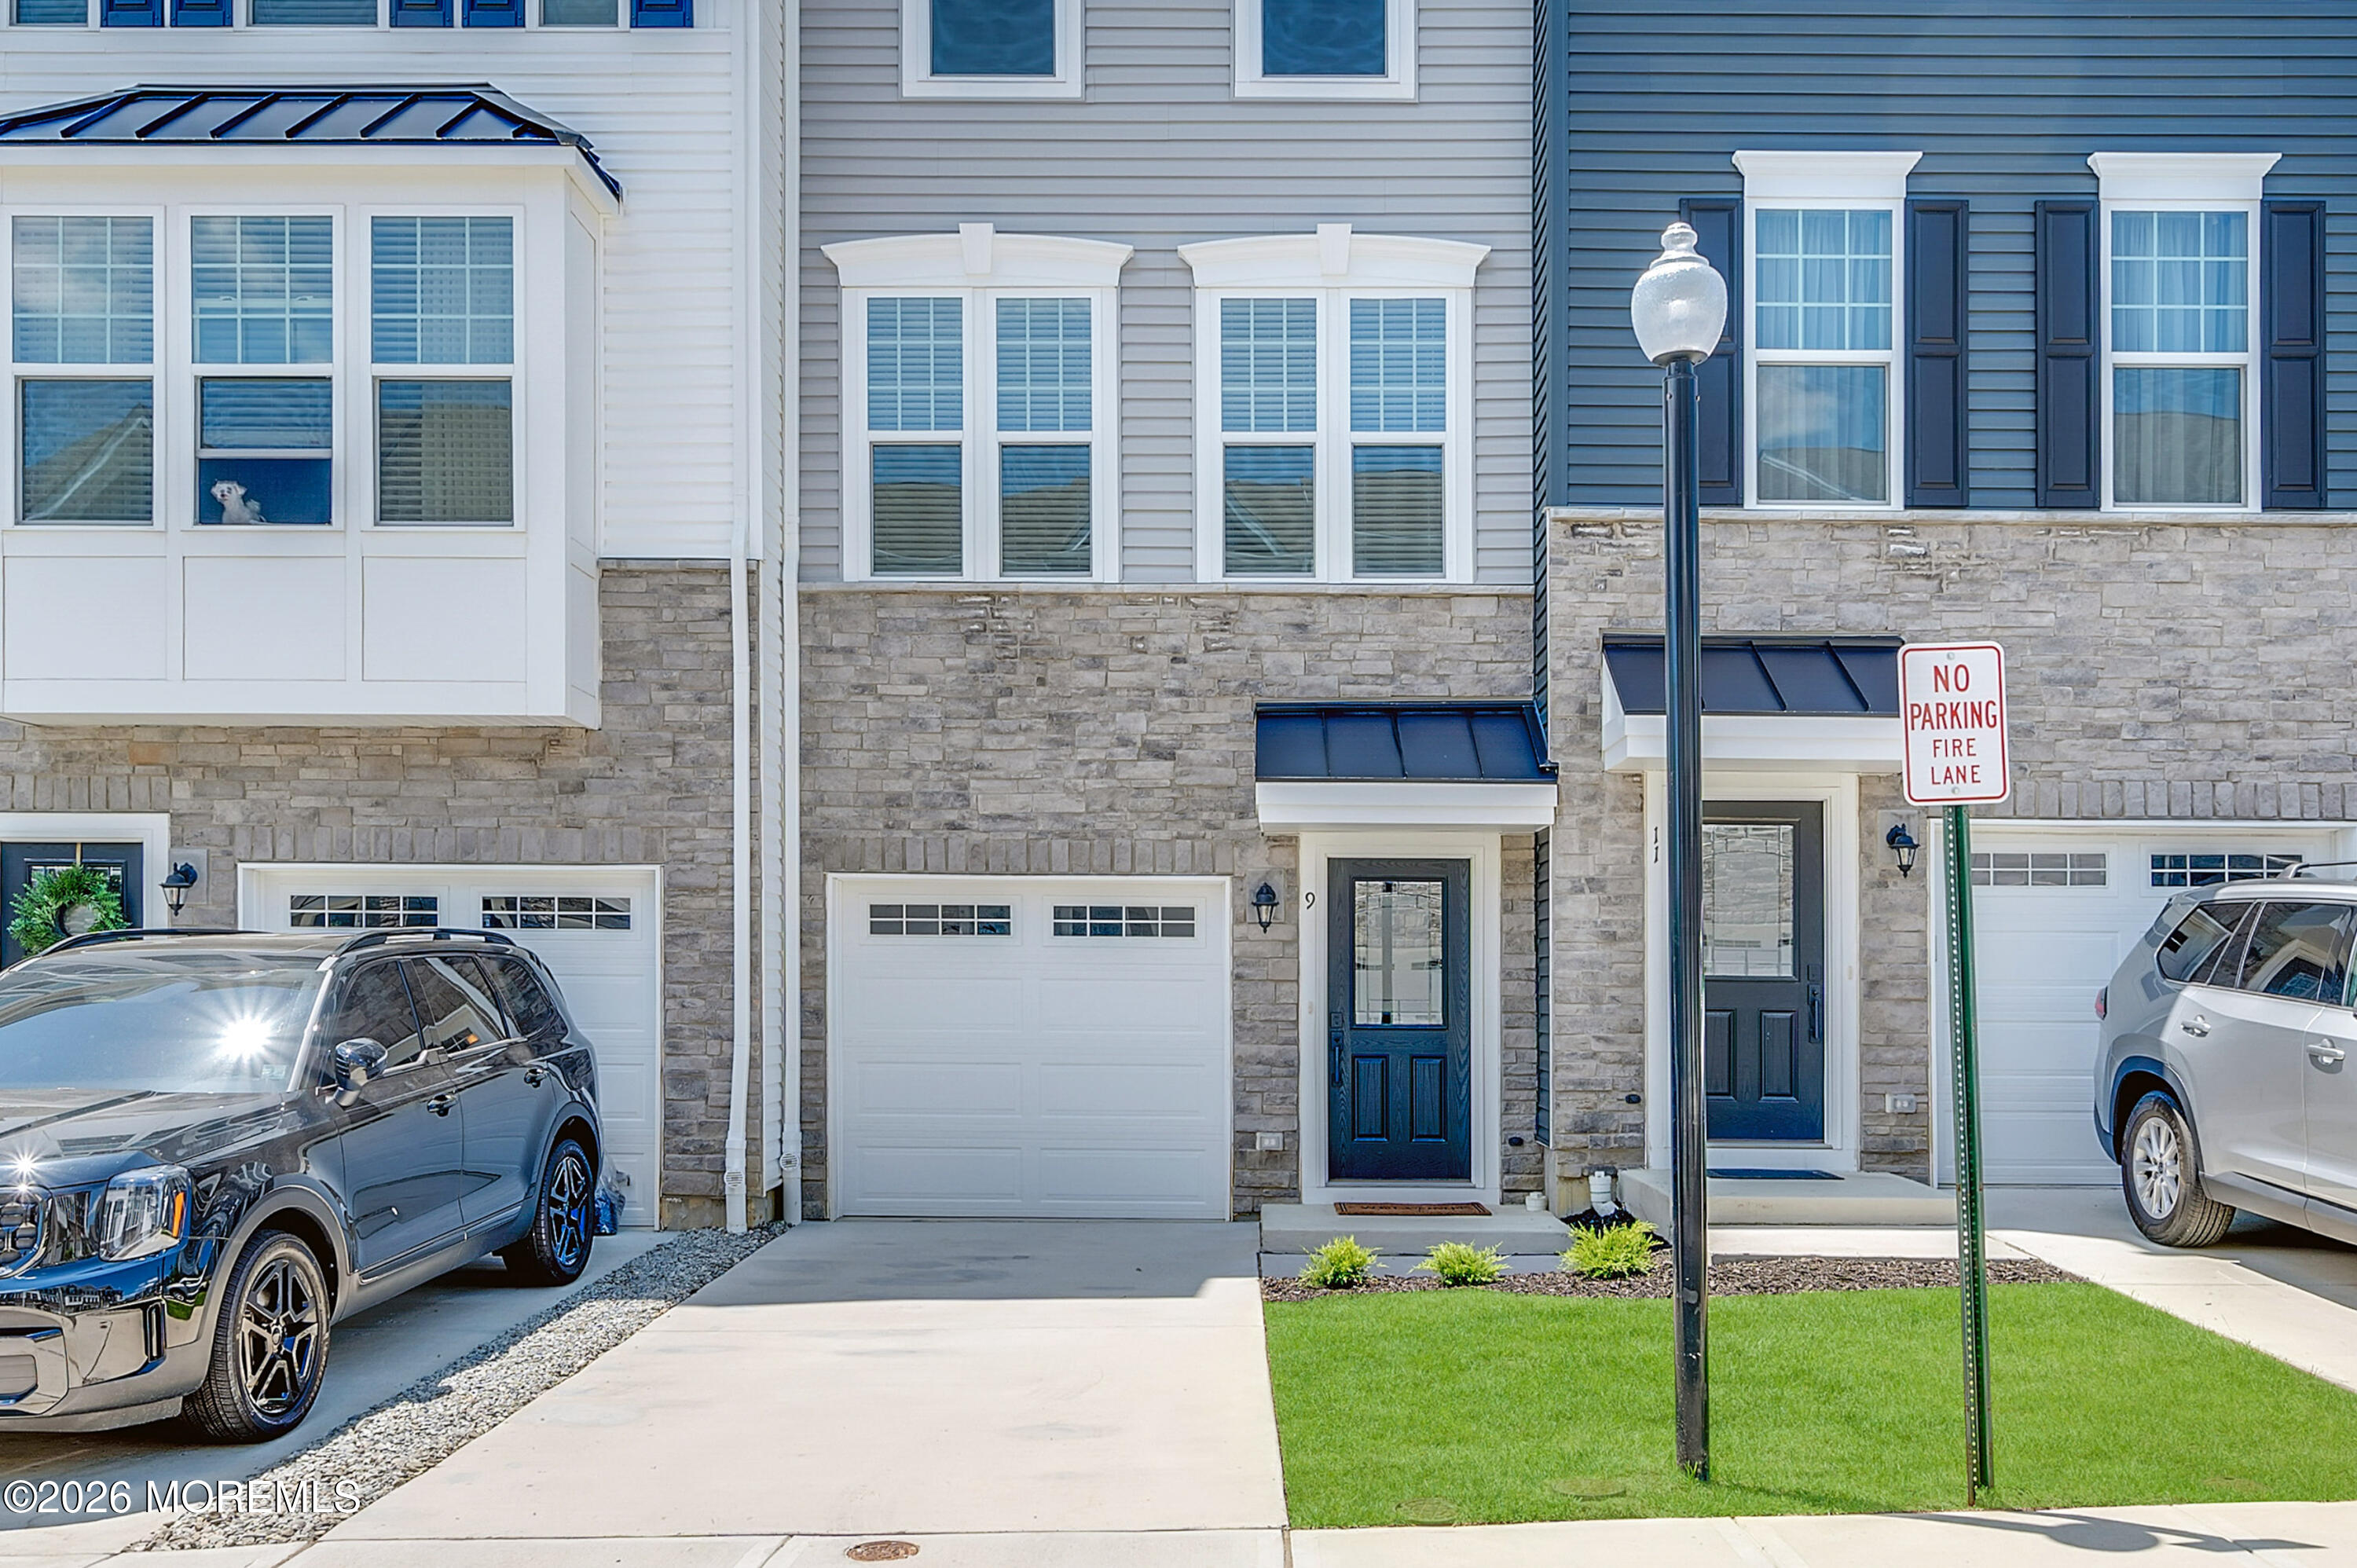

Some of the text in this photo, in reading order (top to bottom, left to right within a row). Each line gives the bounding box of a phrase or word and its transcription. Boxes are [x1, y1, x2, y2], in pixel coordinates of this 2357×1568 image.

[1934, 664, 1970, 693] NO
[1910, 700, 1997, 731] PARKING
[1933, 738, 1977, 758] FIRE
[1931, 764, 1981, 785] LANE
[1653, 826, 1659, 864] 11
[1305, 891, 1316, 910] 9
